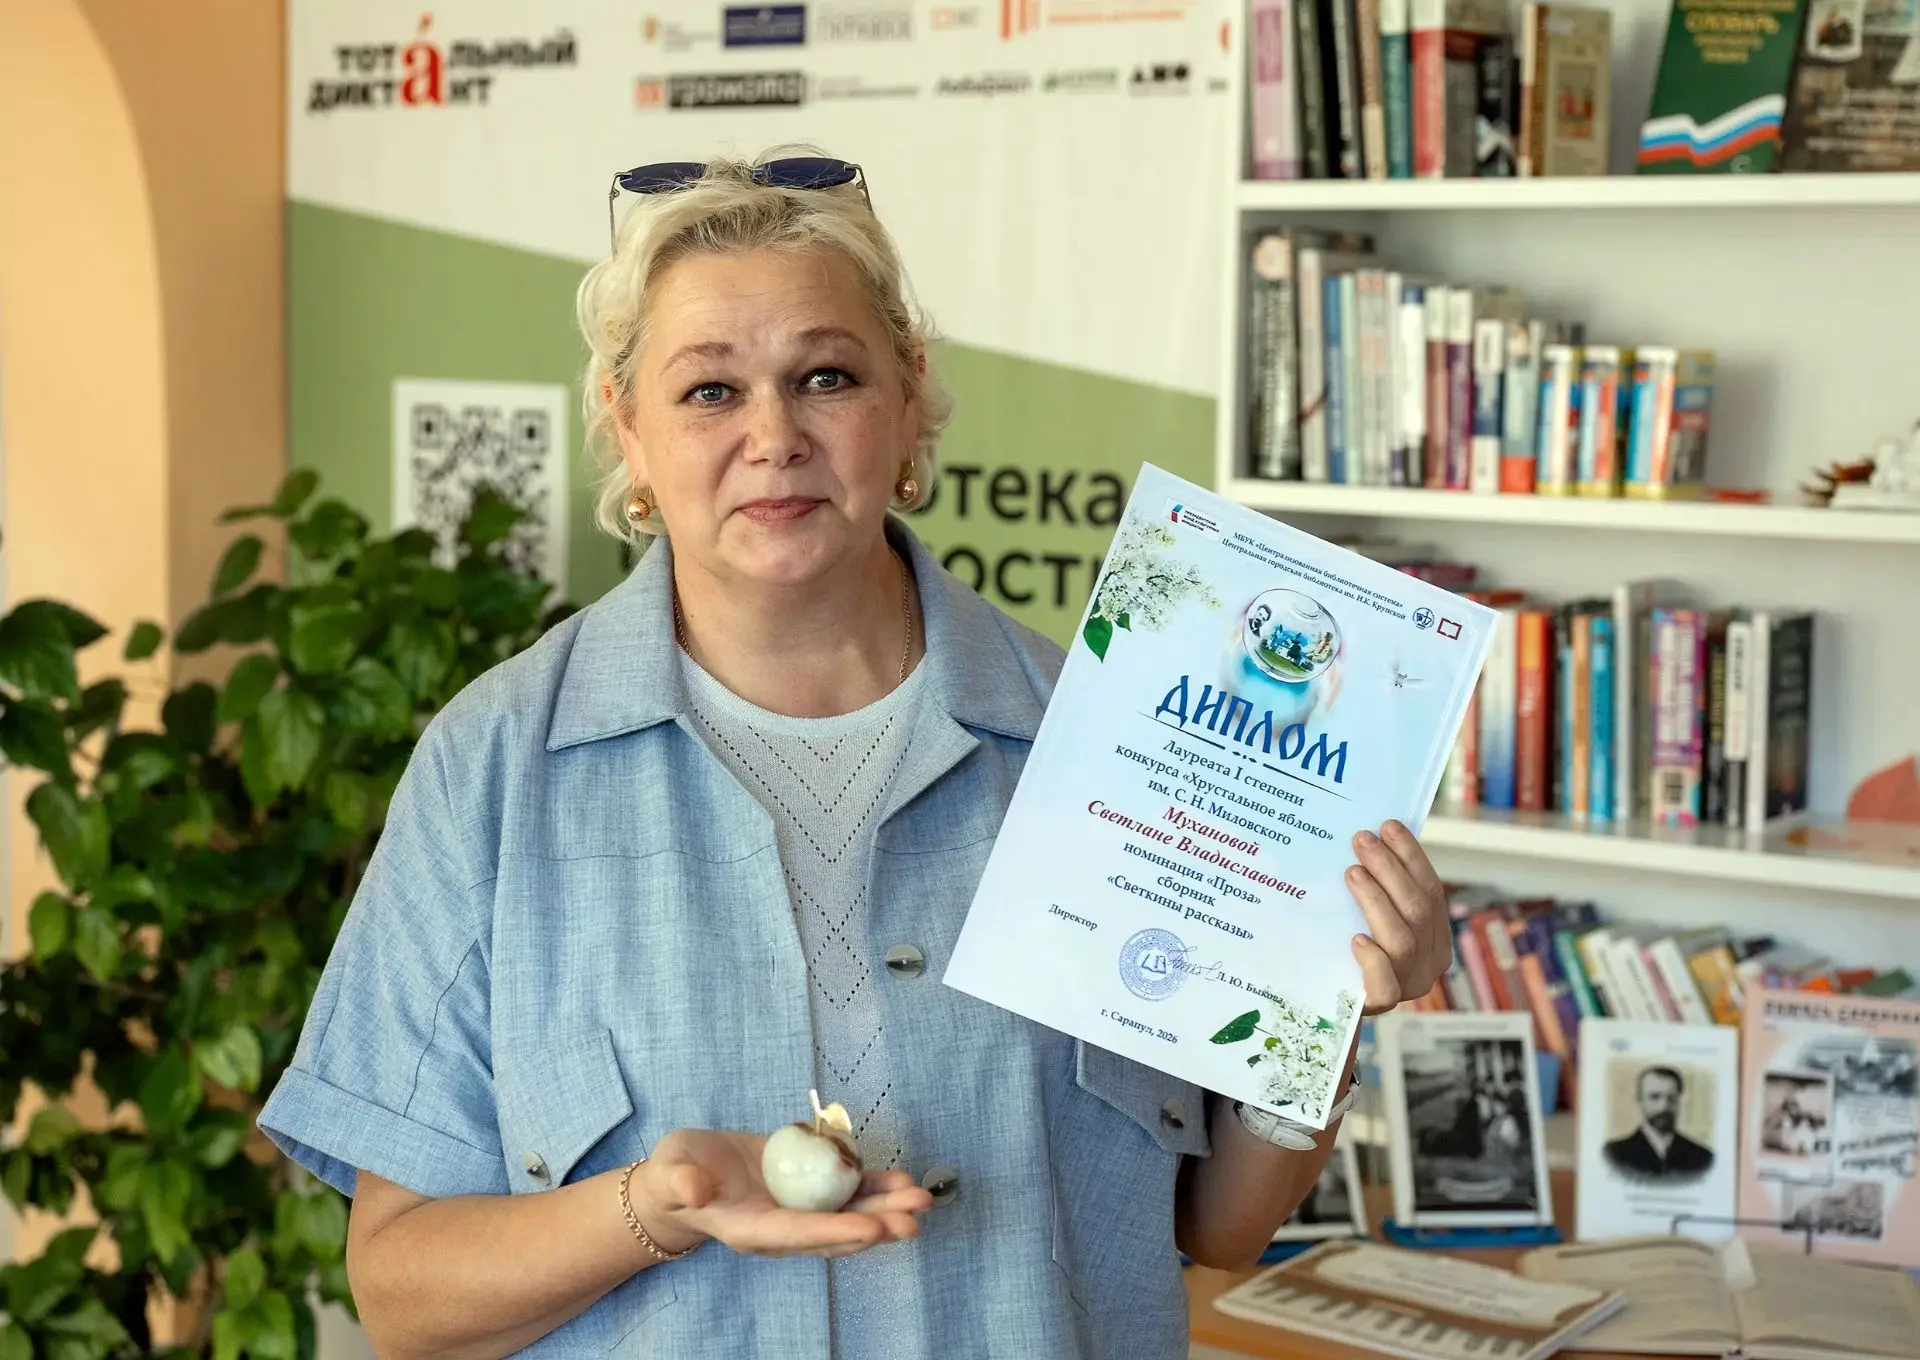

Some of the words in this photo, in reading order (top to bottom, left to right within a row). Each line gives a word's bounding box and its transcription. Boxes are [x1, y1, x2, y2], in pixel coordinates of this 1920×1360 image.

[1222, 538, 1267, 562] Центральная
[1267, 560, 1303, 577] городская
[1303, 572, 1343, 595] библиотека
[1343, 590, 1355, 601] им.
[1371, 602, 1406, 620] Крупской
[1233, 532, 1256, 546] МБУК
[1255, 543, 1322, 574] «Централизованная
[1323, 570, 1372, 596] библиотечная
[1372, 592, 1403, 608] система»
[1155, 675, 1348, 783] ДИПЛОМ
[1115, 744, 1180, 778] конкурса
[1183, 773, 1276, 818] «Хрустальное
[1279, 812, 1334, 842] яблоко»
[1163, 739, 1230, 777] Лауреата
[1244, 775, 1305, 807] степени
[1147, 779, 1170, 796] им.
[1175, 788, 1187, 804] С.
[1190, 794, 1205, 811] Н.
[1208, 802, 1292, 846] Миловского
[1162, 805, 1261, 857] Мухановой
[1087, 799, 1174, 845] Светлане
[1176, 836, 1307, 900] Владиславовне
[1123, 842, 1204, 882] номинация
[1207, 875, 1262, 905] «Проза»
[1048, 903, 1098, 931] Директор
[1107, 875, 1182, 912] «Светкины
[1184, 905, 1254, 940] рассказы»
[1157, 875, 1216, 907] сборник
[1216, 971, 1226, 982] Л.
[1229, 976, 1244, 989] Ю.
[1246, 983, 1284, 1004] Быкова
[1101, 1008, 1108, 1017] г.
[1110, 1011, 1155, 1036] Сарапул,
[1156, 1028, 1179, 1044] 2026
